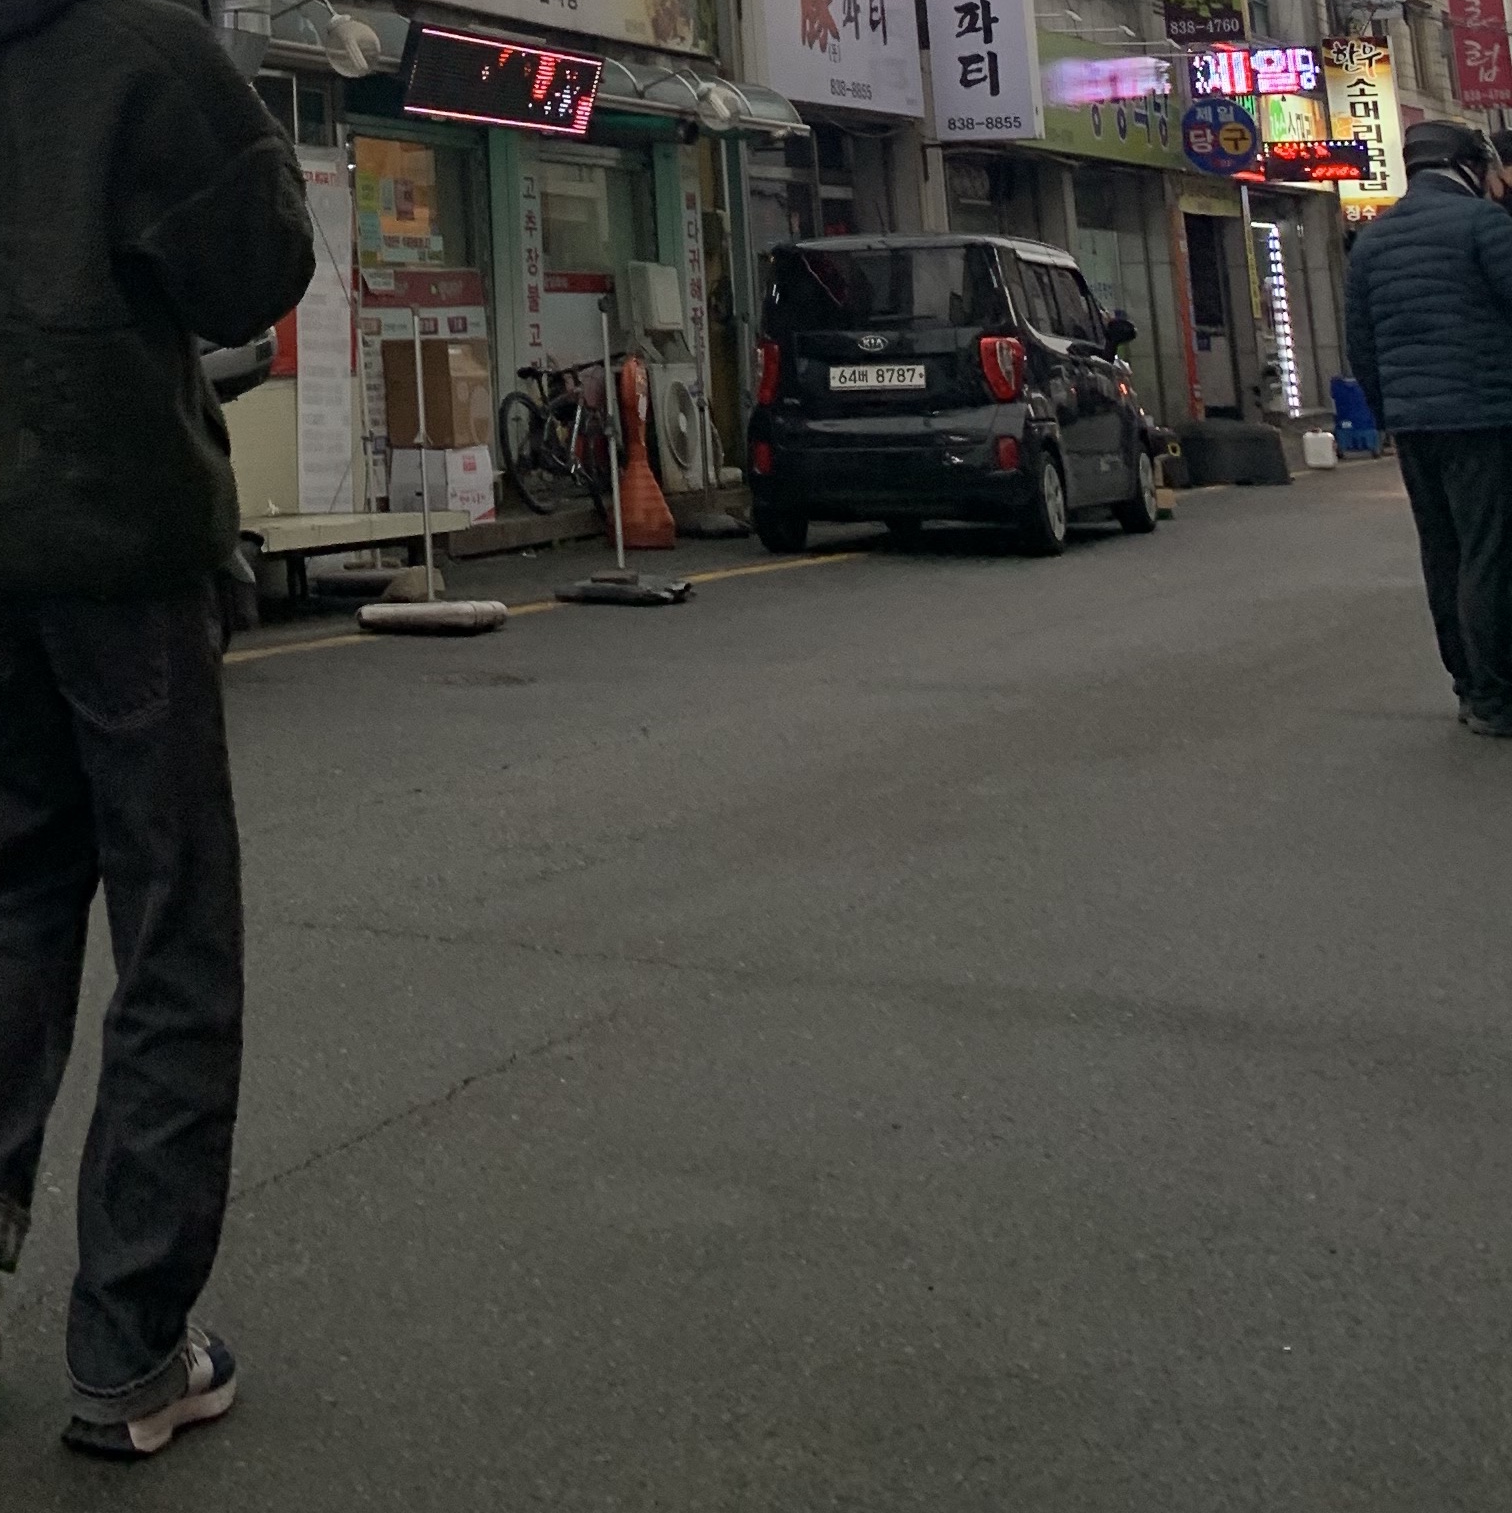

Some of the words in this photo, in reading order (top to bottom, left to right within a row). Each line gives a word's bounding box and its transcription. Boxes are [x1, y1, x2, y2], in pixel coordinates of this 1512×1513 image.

[1170, 17, 1240, 35] 838-4760
[1333, 41, 1383, 78] 한우
[830, 79, 873, 101] 838-8855
[947, 116, 1022, 131] 838-8855
[876, 368, 916, 384] 8787
